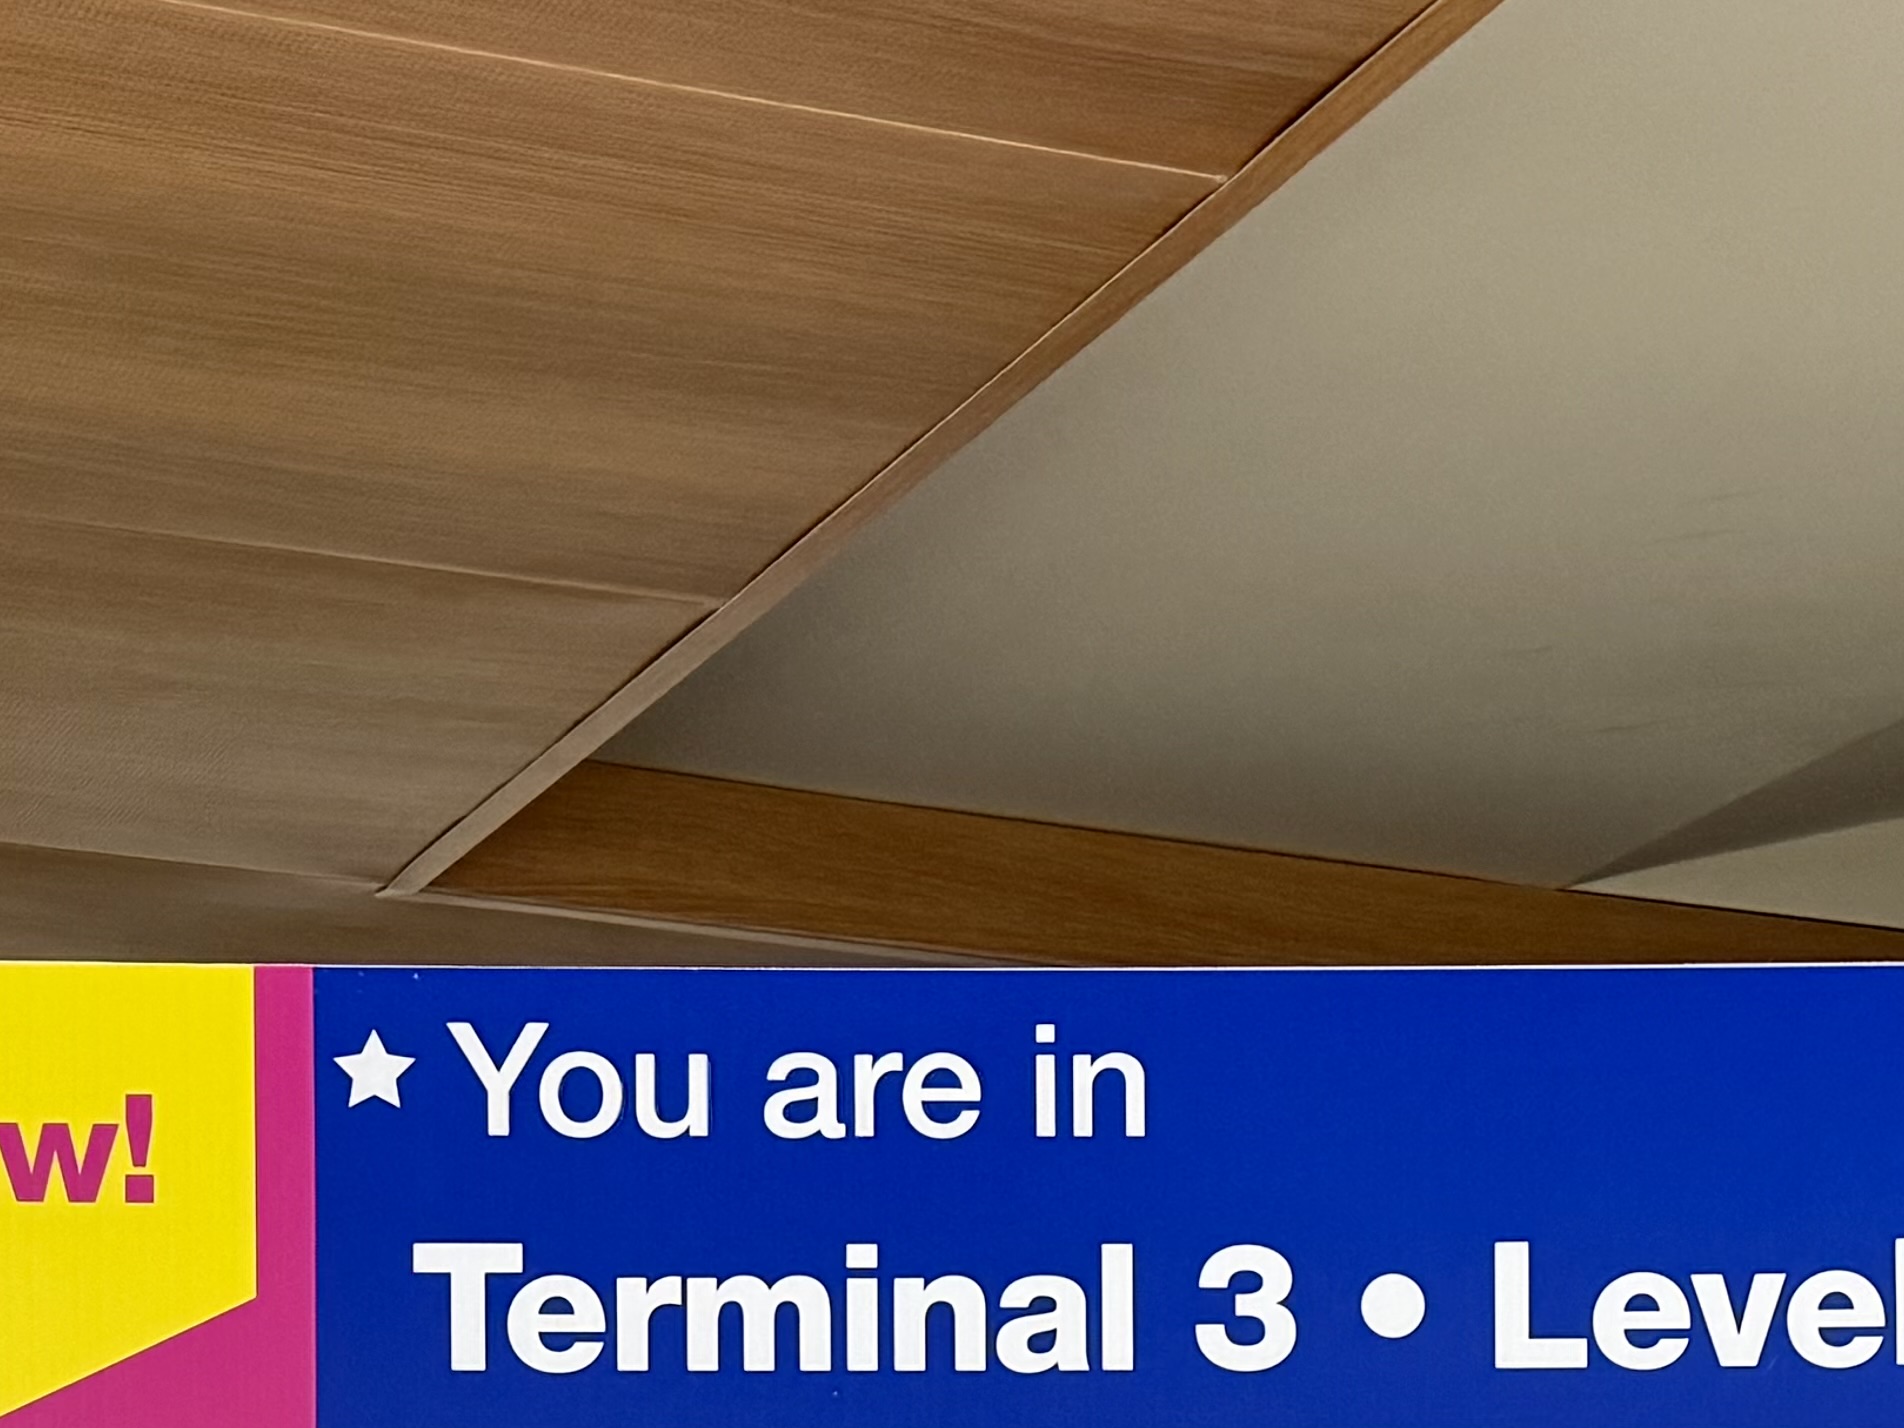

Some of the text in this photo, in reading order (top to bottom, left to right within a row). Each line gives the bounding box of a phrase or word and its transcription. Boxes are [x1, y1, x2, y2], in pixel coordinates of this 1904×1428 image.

[447, 1022, 1147, 1141] You are in
[413, 1243, 1135, 1375] Terminal
[1196, 1245, 1298, 1373] 3
